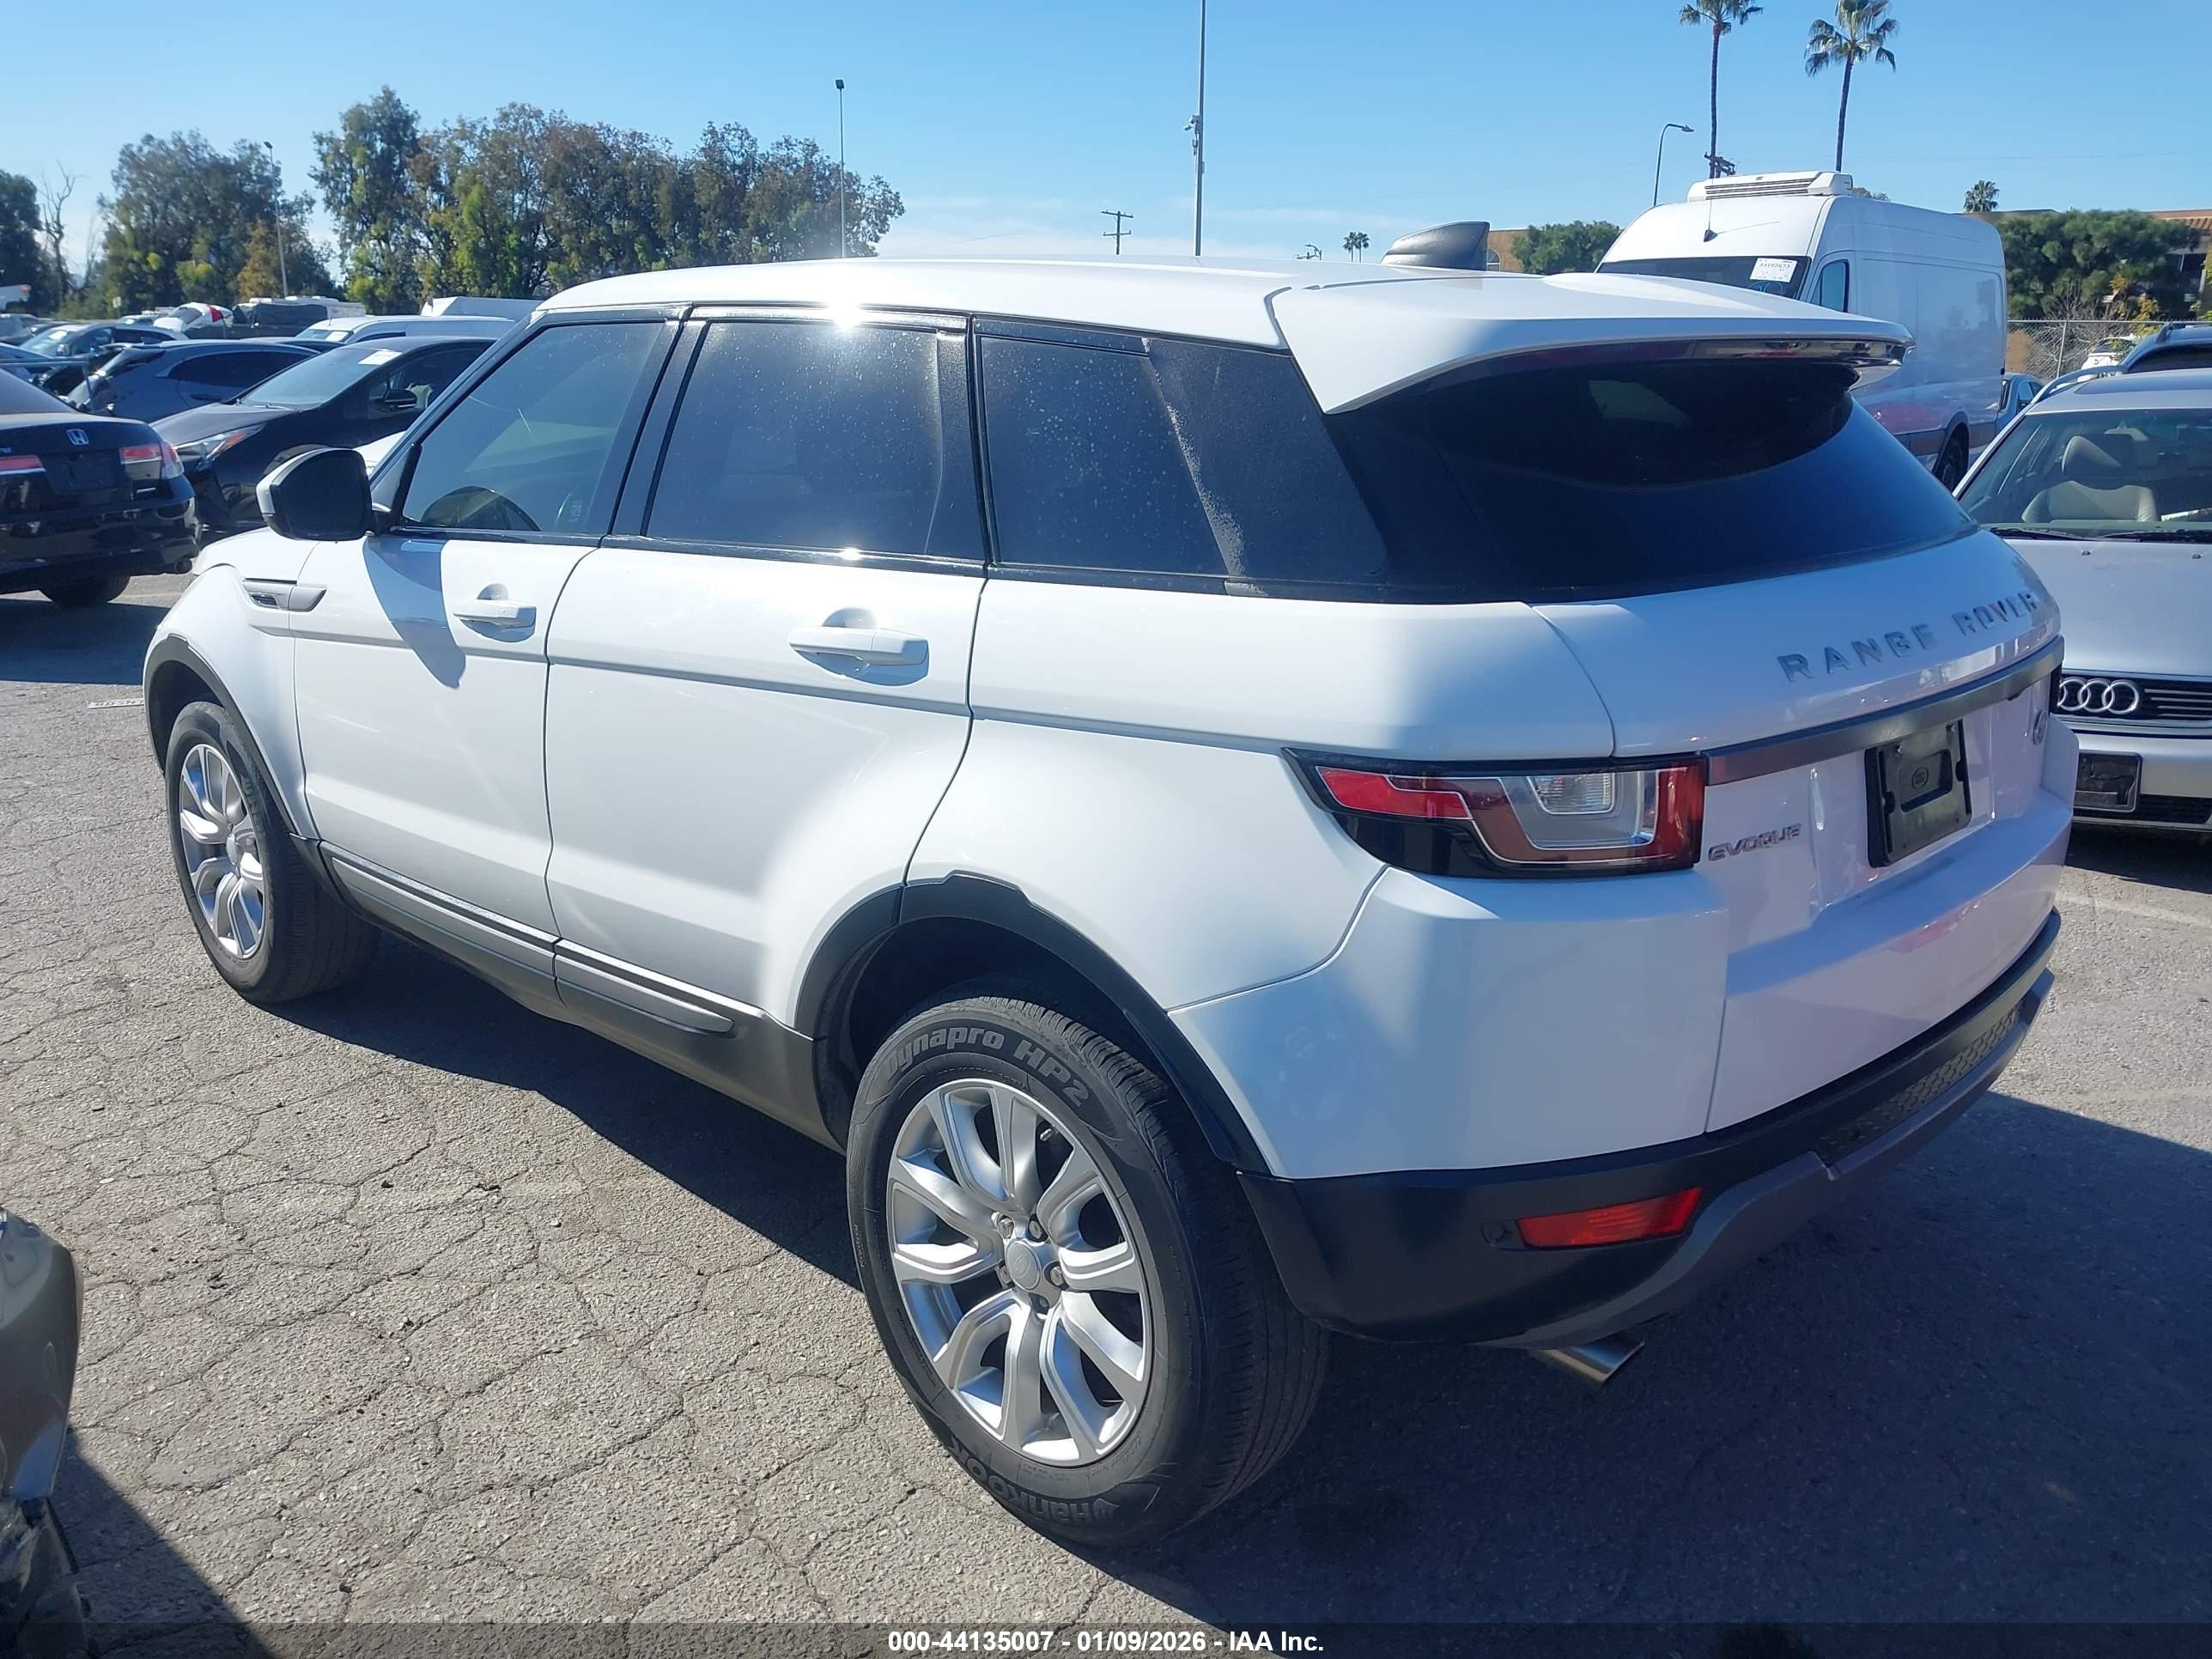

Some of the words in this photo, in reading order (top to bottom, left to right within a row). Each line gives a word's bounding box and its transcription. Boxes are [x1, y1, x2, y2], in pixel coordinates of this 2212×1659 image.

[1777, 623, 1939, 683] RANGE
[1952, 590, 2039, 636] ROVER
[1706, 823, 1802, 861] EVOQUE
[886, 1026, 1005, 1079] Dynapro
[1013, 1039, 1091, 1108] HP2
